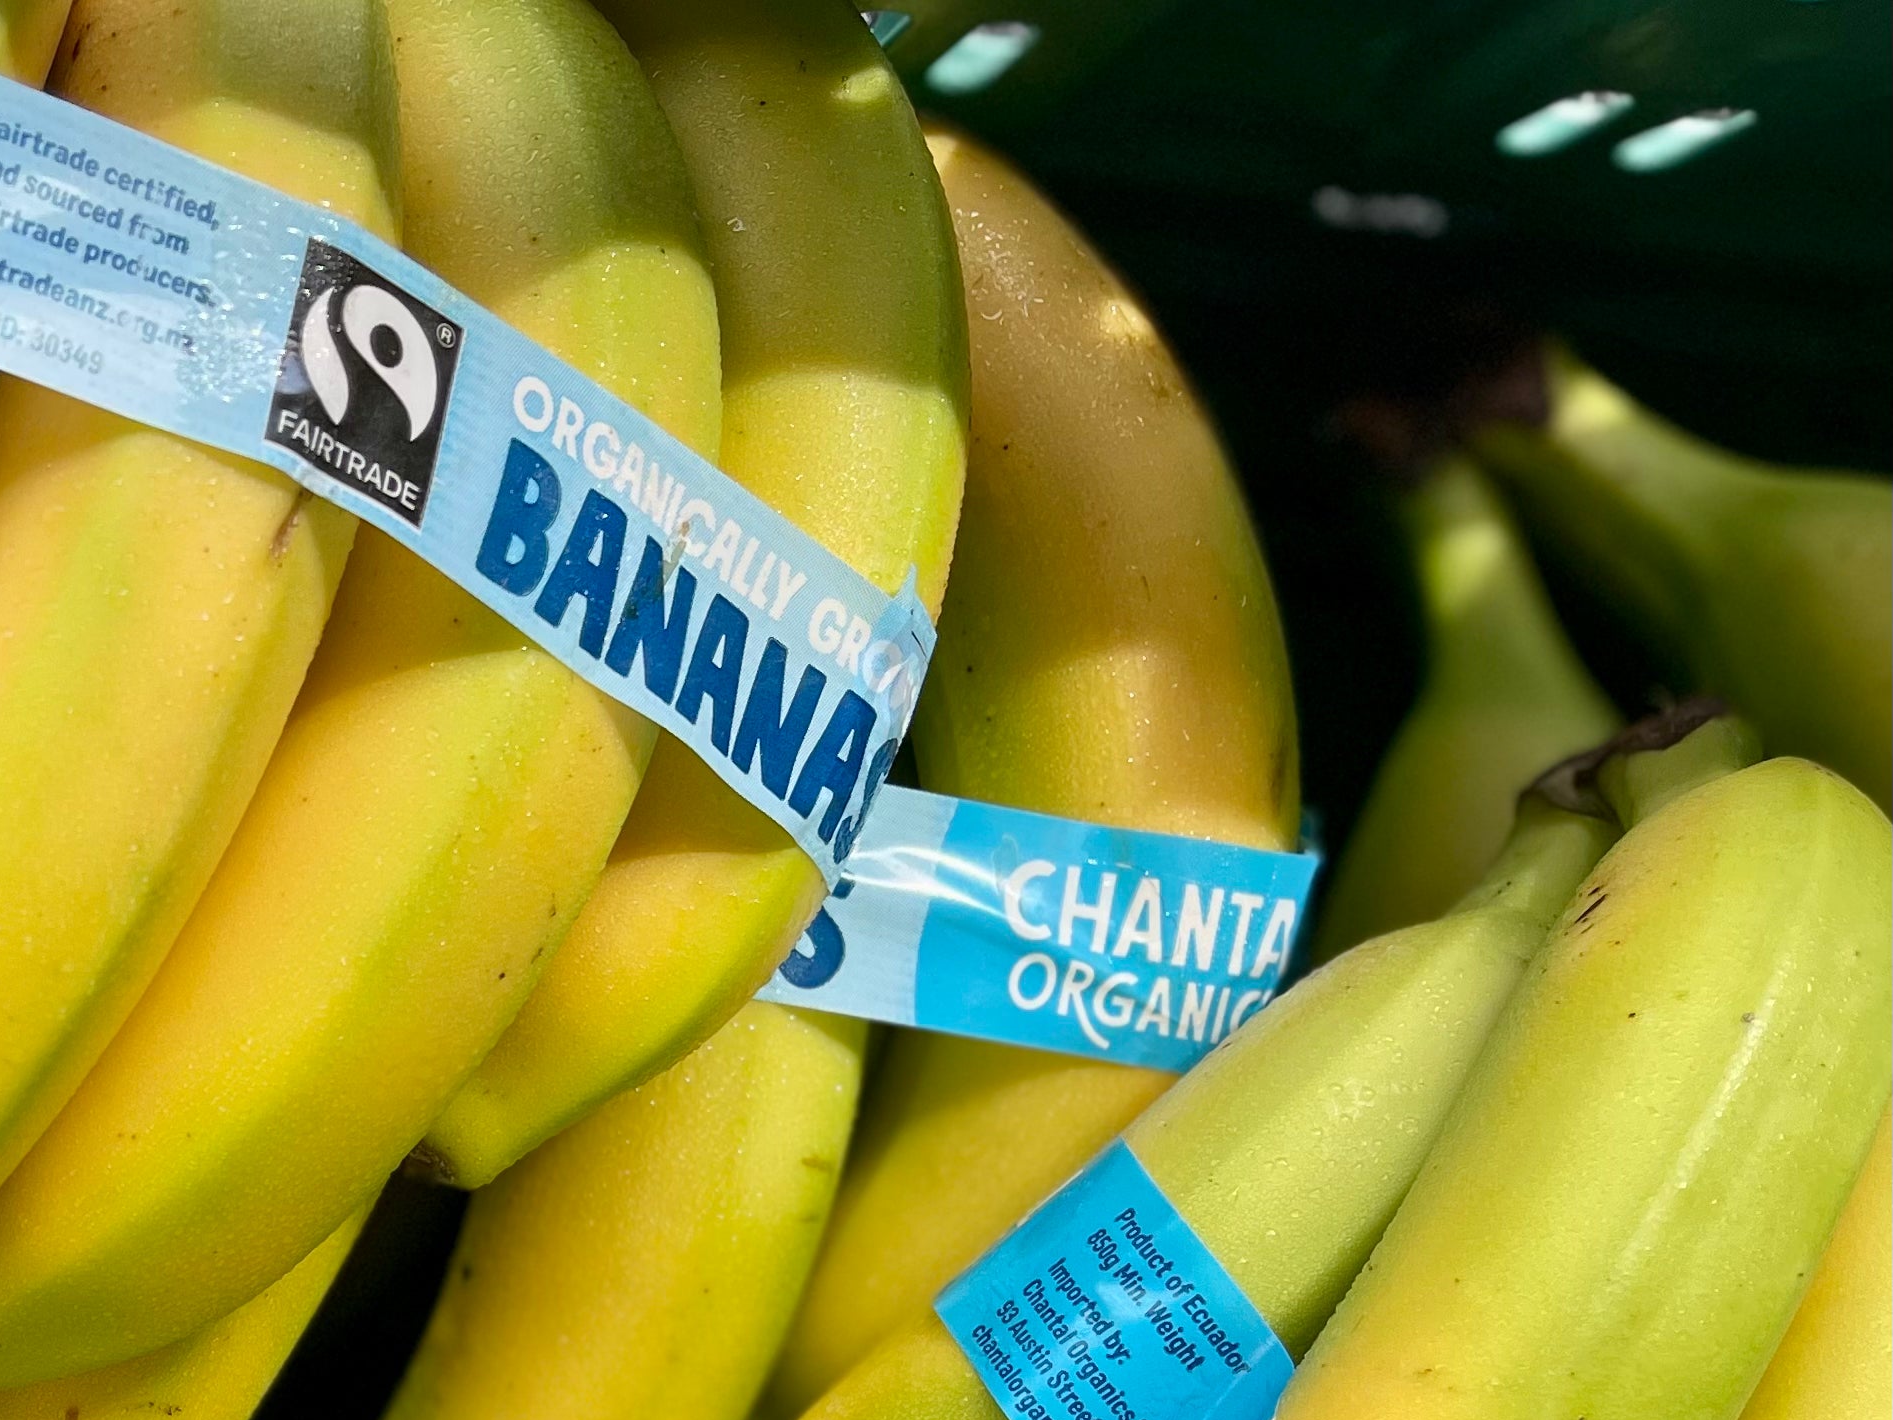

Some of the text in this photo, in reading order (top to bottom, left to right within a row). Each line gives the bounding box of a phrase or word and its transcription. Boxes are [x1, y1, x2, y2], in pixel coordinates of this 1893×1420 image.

[23, 173, 124, 230] sourced
[128, 213, 190, 255] from
[82, 242, 217, 308] producers.
[27, 324, 104, 375] 30349
[277, 409, 420, 511] FAIRTRADE
[512, 375, 914, 714] ORGANICALLY GRO
[475, 437, 899, 865] BANANAS
[1005, 859, 1297, 980] CHANTA
[1009, 952, 1274, 1049] ORGANIC
[995, 1299, 1020, 1325] 93
[1008, 1319, 1055, 1376] Austin
[1022, 1278, 1079, 1346] Chantal
[1047, 1256, 1131, 1366] Imported by:
[1086, 1228, 1206, 1373] 850g Min. Weight
[1114, 1207, 1252, 1376] Product of Ecuador
